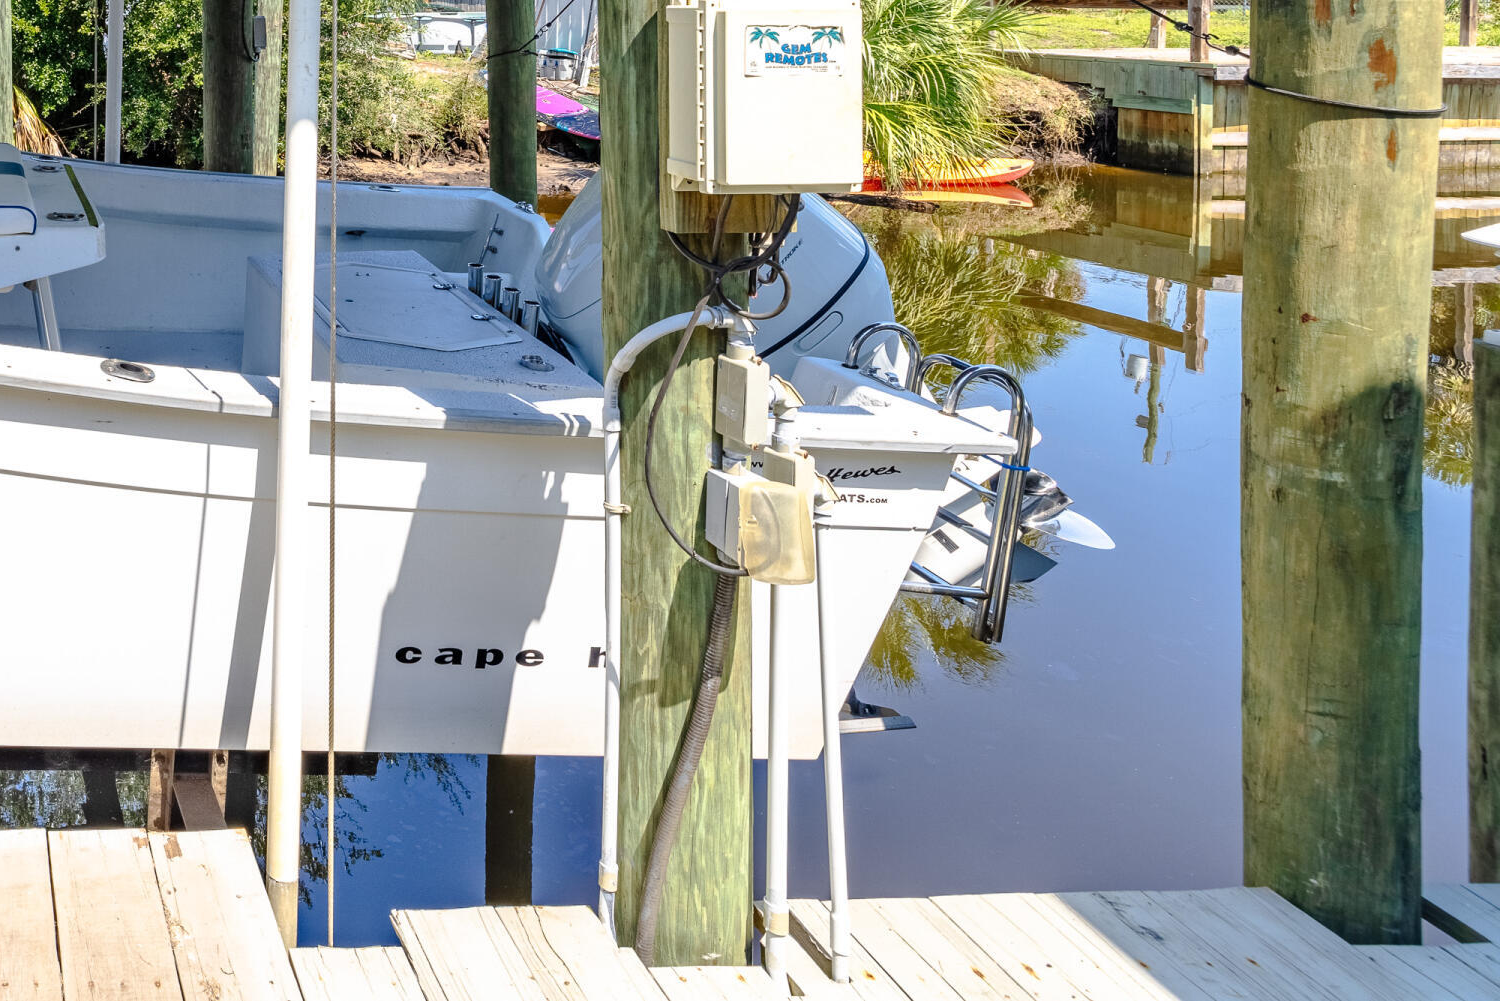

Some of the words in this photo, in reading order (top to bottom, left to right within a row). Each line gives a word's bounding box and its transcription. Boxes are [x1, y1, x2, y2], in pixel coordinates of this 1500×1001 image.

[781, 43, 812, 55] GEM
[764, 52, 829, 66] REMOTES
[780, 237, 804, 265] TROKE
[395, 646, 544, 669] cape
